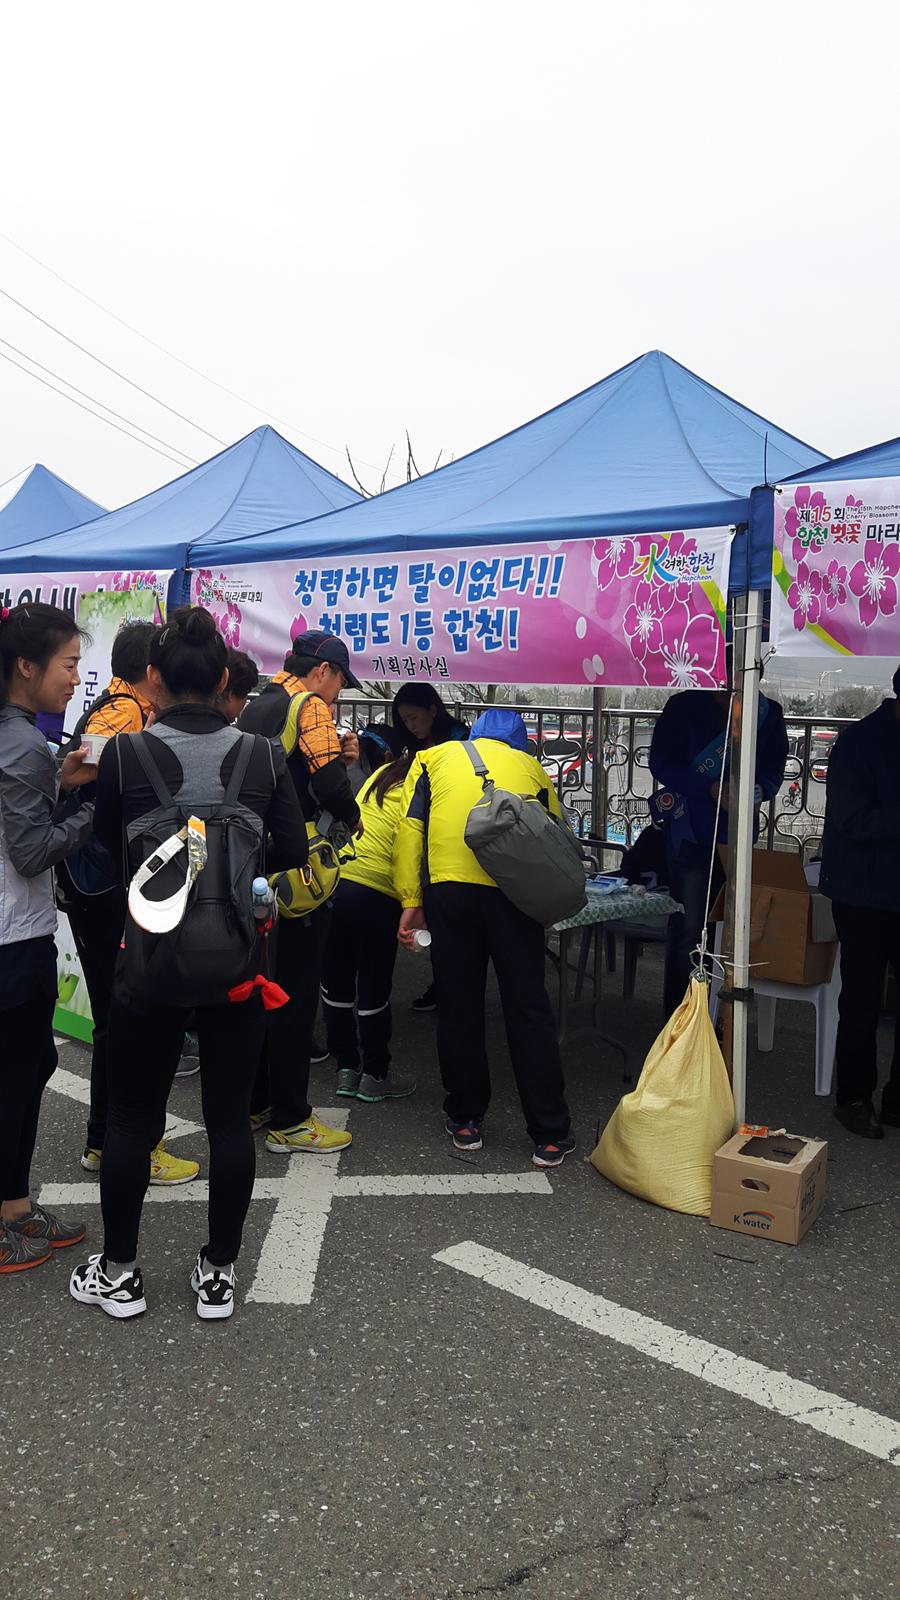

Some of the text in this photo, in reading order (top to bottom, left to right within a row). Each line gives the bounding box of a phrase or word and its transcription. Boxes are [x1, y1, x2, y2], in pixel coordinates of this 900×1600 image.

[800, 506, 845, 522] 제15회
[846, 512, 867, 520] Cherry
[798, 526, 828, 547] 합천
[831, 523, 861, 544] 벚꽃
[688, 552, 715, 573] 합천
[294, 555, 565, 608] 청렴하면 탈이없다!!
[682, 574, 712, 583] Hapcheon
[400, 610, 435, 651] 1등
[443, 607, 519, 652] 합천!
[372, 654, 450, 677] 기획감사실
[743, 1218, 771, 1230] water
